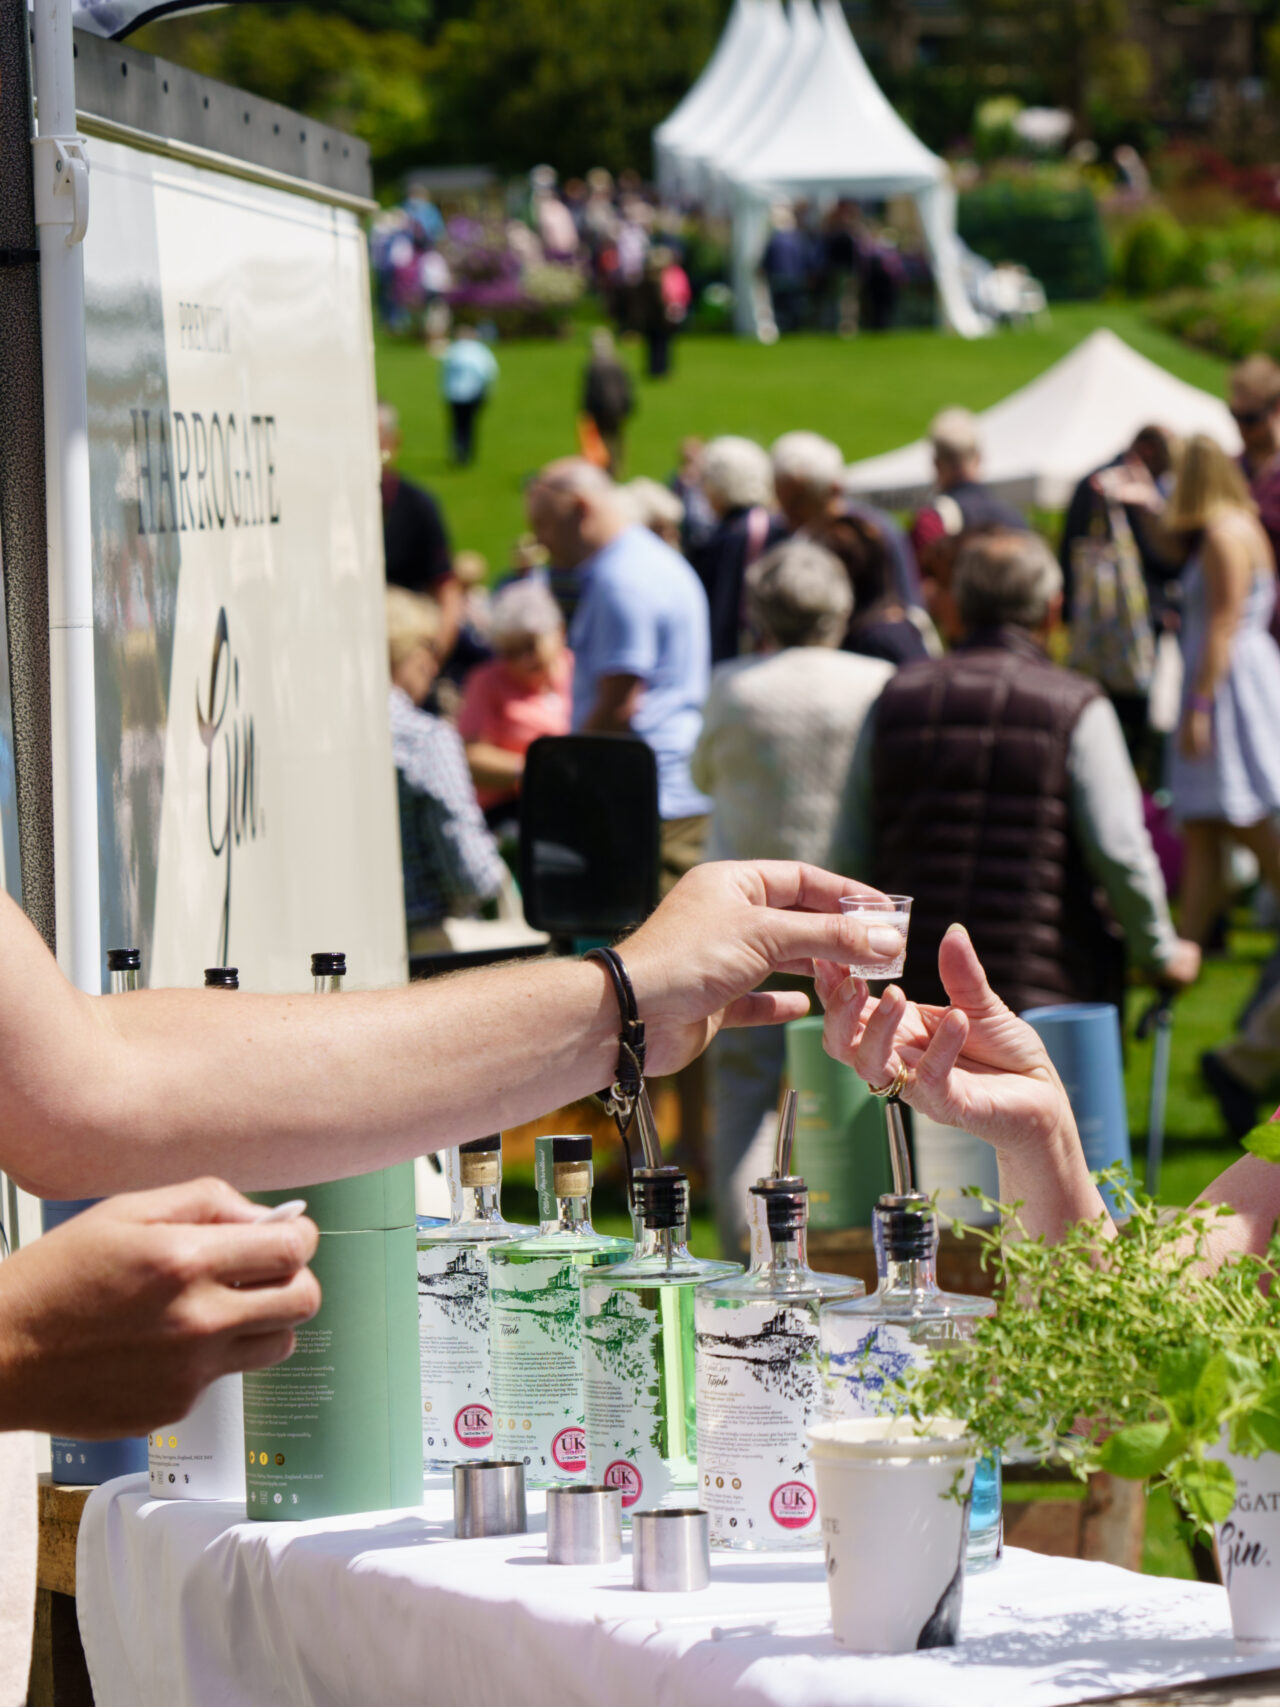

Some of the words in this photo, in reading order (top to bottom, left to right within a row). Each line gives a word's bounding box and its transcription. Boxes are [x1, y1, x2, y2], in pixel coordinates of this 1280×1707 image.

[130, 409, 280, 535] HARROGATE
[463, 1413, 488, 1427] UK
[561, 1437, 586, 1451] UK
[610, 1471, 632, 1485] UK
[780, 1491, 807, 1506] UK
